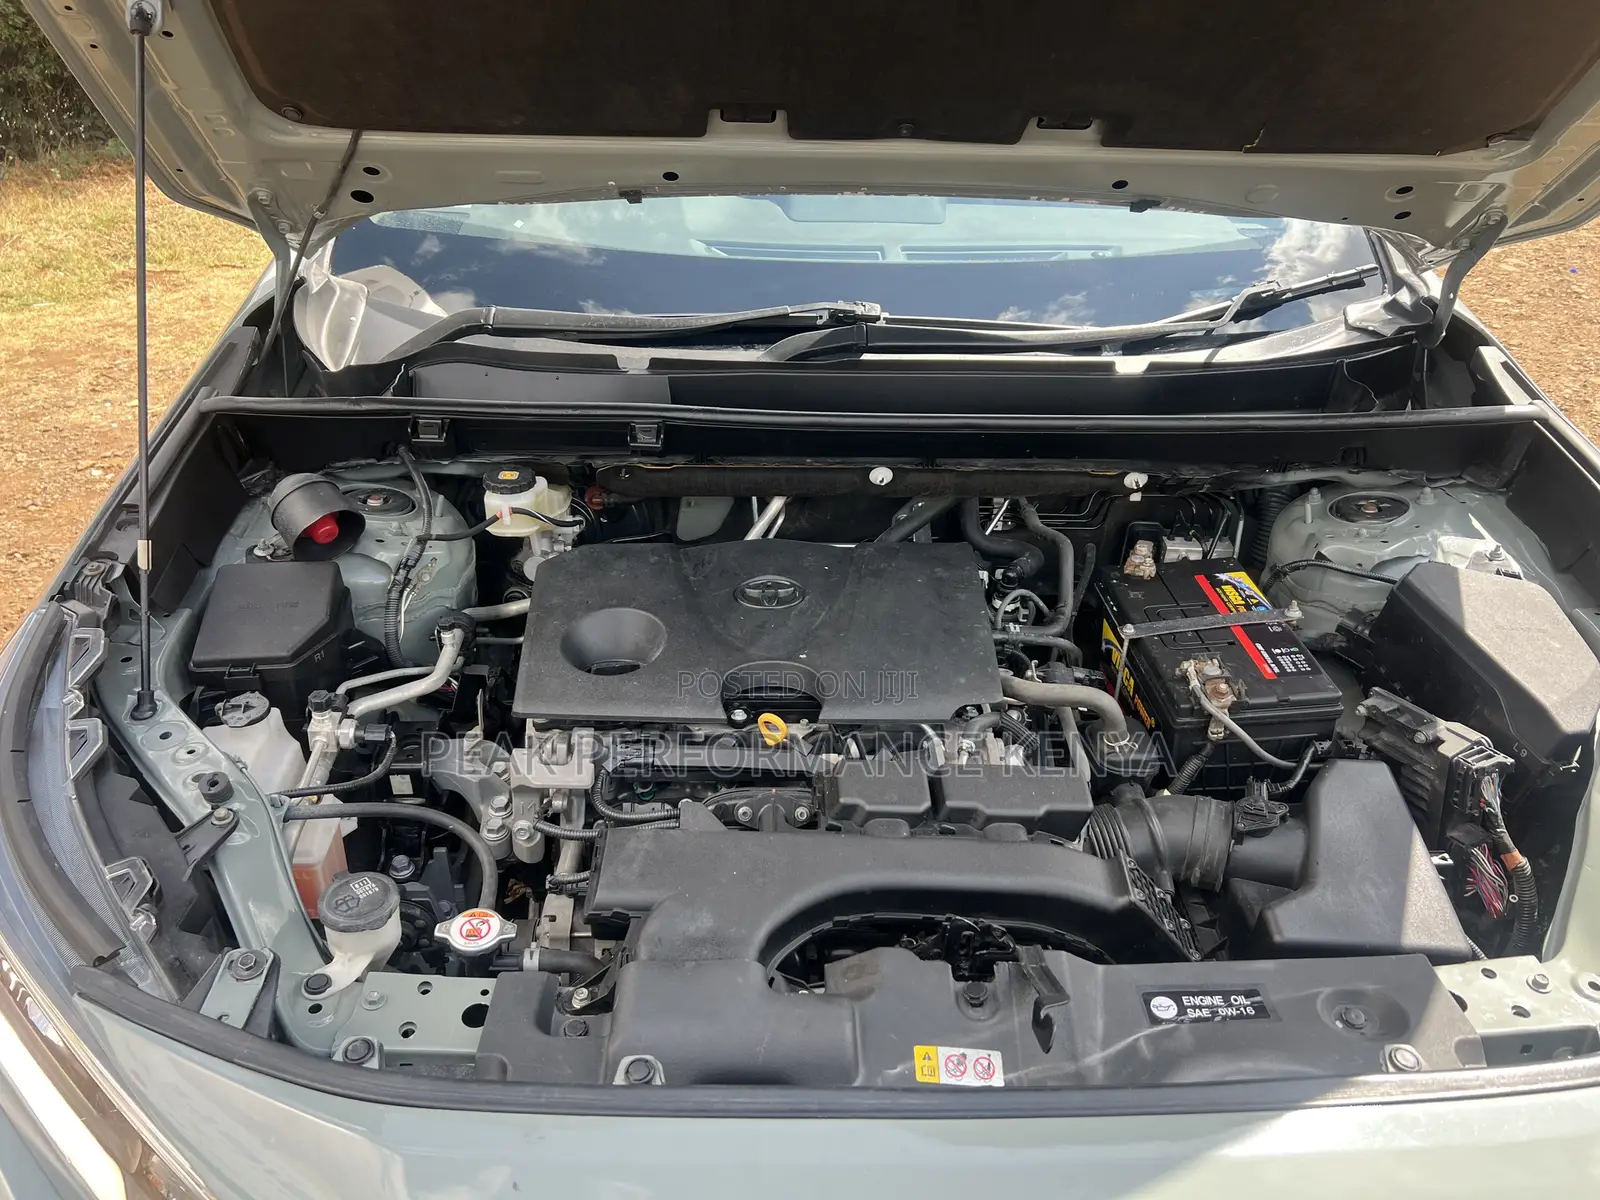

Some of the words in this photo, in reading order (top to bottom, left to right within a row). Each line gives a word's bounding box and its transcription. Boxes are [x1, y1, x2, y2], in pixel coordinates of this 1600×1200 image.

[1111, 647, 1135, 698] VICA
[1181, 995, 1225, 1006] ENGINE
[1230, 995, 1251, 1005] OIL
[1186, 1008, 1212, 1018] SAE
[1217, 1006, 1255, 1017] 0W-16
